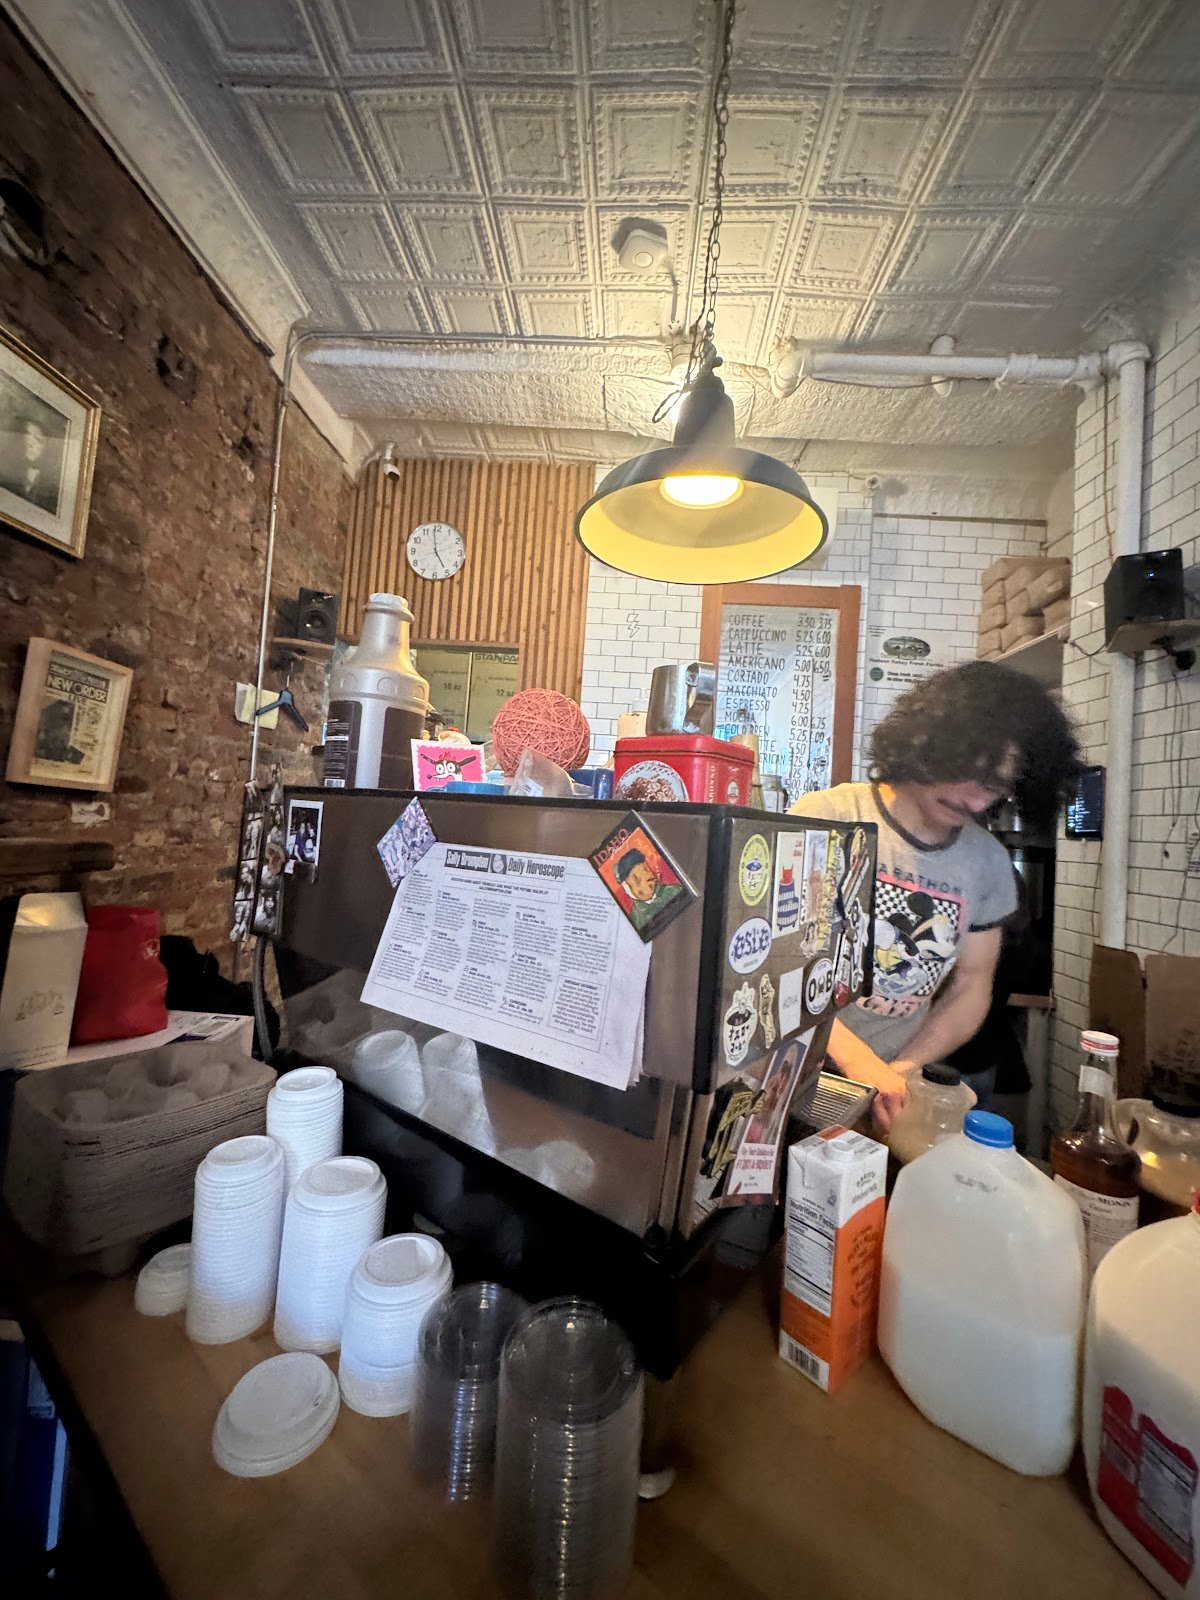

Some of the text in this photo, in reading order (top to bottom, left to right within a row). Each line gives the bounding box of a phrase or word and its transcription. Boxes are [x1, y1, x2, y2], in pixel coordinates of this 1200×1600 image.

[423, 528, 429, 536] 11
[433, 525, 442, 533] 12
[413, 536, 421, 544] 10
[410, 547, 416, 555] 9
[444, 569, 450, 577] 5
[728, 614, 765, 628] COFFEE
[728, 628, 787, 642] CAPPUCCINO
[728, 641, 764, 656] LATTE
[727, 655, 786, 671] AMERICANO
[727, 669, 770, 685] CORTADO
[46, 674, 74, 692] NEW
[73, 683, 107, 703] ORDER
[726, 685, 777, 699] MACCHIATO
[725, 697, 771, 712] ESPRESSO
[724, 711, 757, 724] MOCHA
[508, 857, 525, 875] Daily
[526, 859, 565, 879] Horoscope
[790, 1200, 818, 1219] Nutrition
[818, 1213, 836, 1230] Facts
